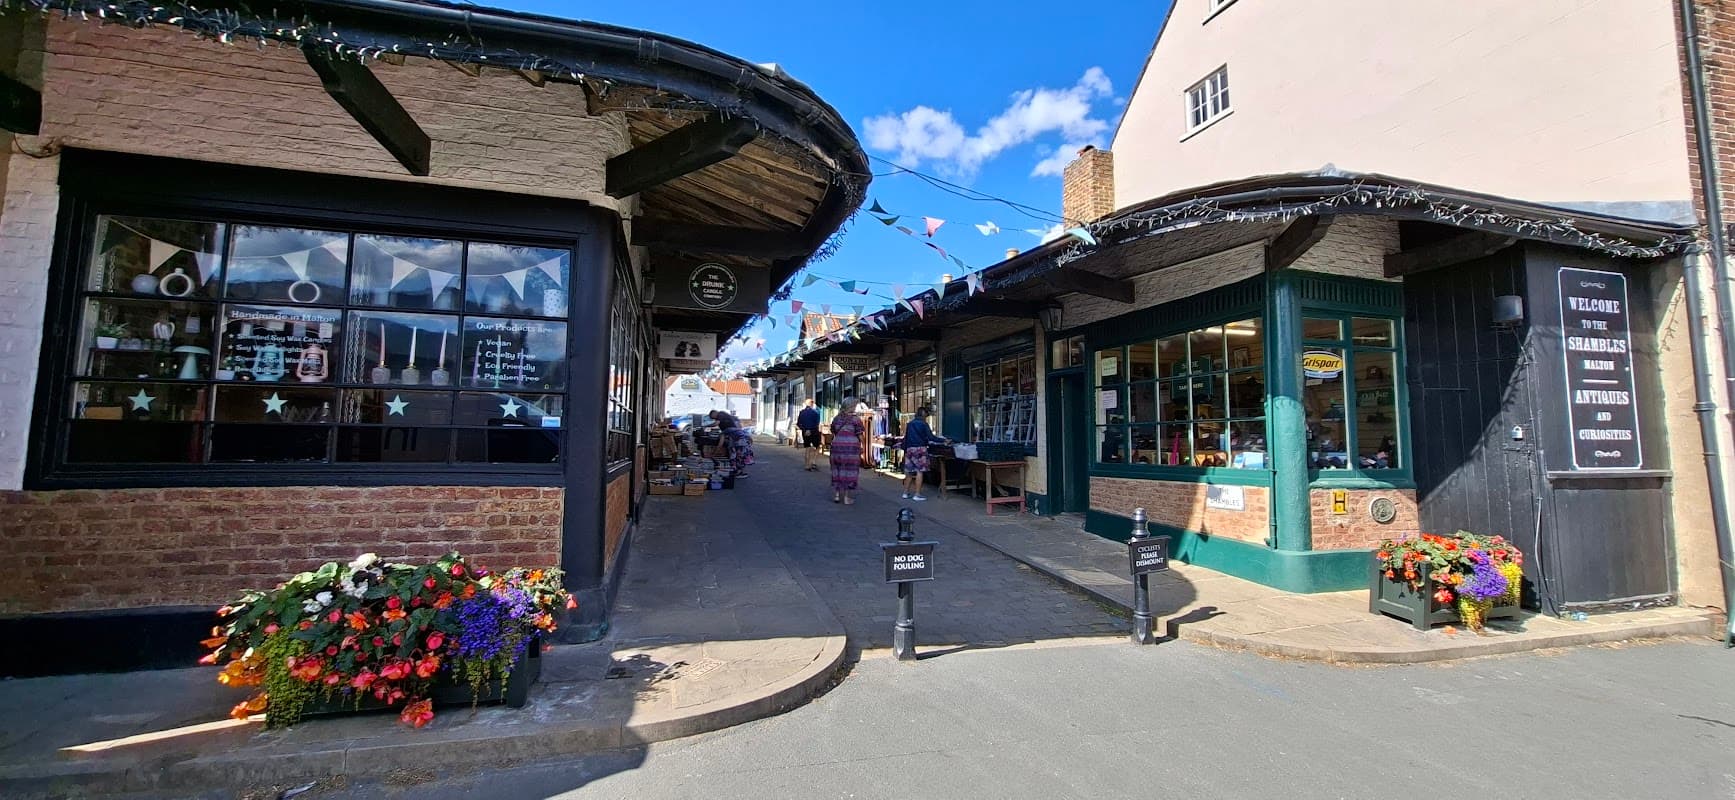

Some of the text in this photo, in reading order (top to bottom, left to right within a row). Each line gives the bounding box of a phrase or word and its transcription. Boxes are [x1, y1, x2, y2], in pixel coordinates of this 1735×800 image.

[702, 280, 725, 288] DRUNK
[1568, 296, 1620, 314] WELCOME
[231, 310, 288, 320] Handmade
[302, 313, 336, 322] Malton
[476, 322, 553, 333] Our Products are
[1581, 319, 1608, 330] TO THE
[270, 334, 286, 343] Soy
[486, 339, 512, 348] Vegan
[1568, 336, 1626, 353] SHAMBLES
[485, 350, 537, 360] Cruelty Free
[502, 363, 536, 372] Friendly
[1303, 358, 1340, 369] Grisport
[1583, 359, 1615, 370] MALTON
[484, 373, 540, 382] Paraben Free
[1575, 389, 1630, 405] ANTIQUES
[1596, 411, 1612, 421] AND
[1579, 429, 1632, 440] CURIOSITIES
[1334, 492, 1346, 512] H
[907, 554, 924, 562] DOG
[1136, 558, 1163, 566] DISMOUNT
[893, 562, 925, 570] FOULING
